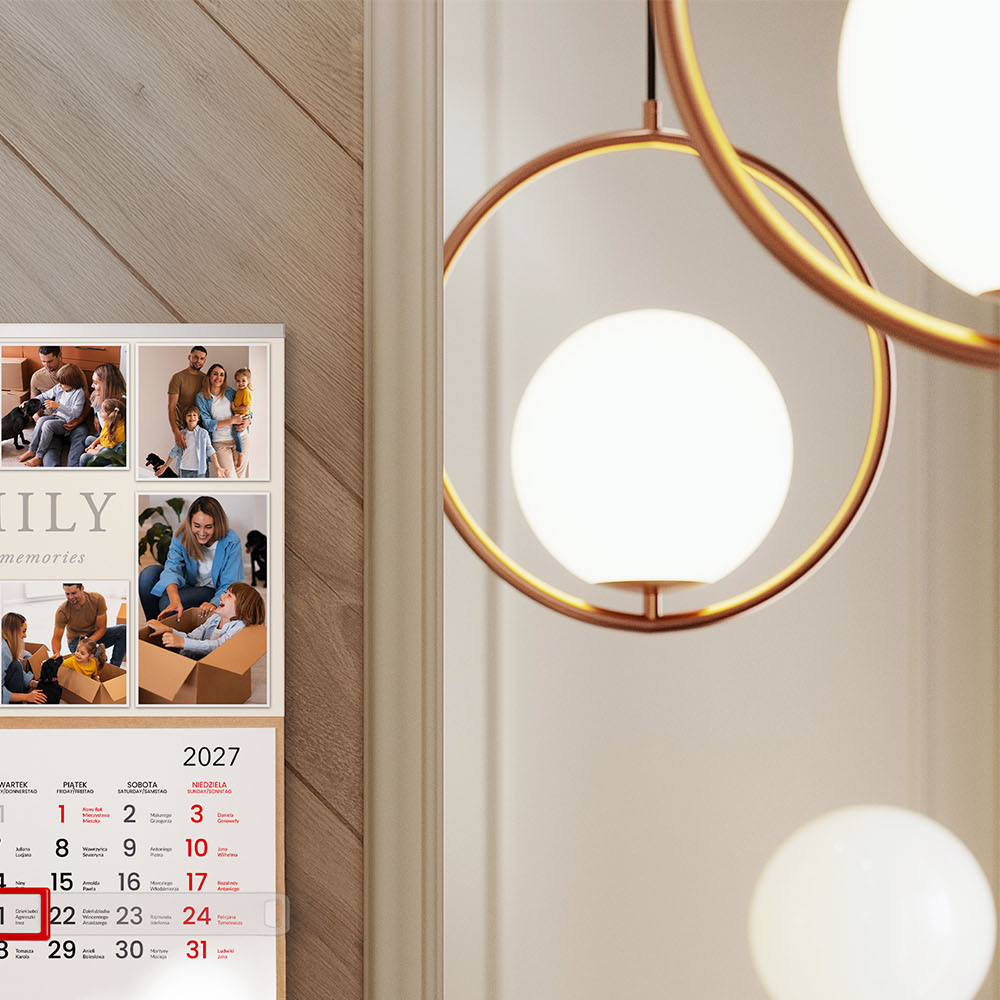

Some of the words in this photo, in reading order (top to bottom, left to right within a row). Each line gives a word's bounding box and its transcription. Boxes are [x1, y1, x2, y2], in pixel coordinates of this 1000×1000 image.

[0, 550, 86, 564] memories
[183, 747, 240, 766] 2027
[63, 781, 87, 789] PIĄTEK
[59, 805, 64, 823] 1
[124, 805, 136, 823] 2
[191, 804, 203, 823] 3
[56, 839, 68, 857] 8
[124, 839, 136, 857] 9
[186, 838, 208, 857] 10
[50, 873, 73, 891] 15
[118, 872, 140, 891] 16
[187, 873, 207, 891] 17
[50, 906, 76, 925] 22
[116, 906, 142, 925] 23
[183, 906, 211, 925] 24
[48, 940, 75, 959] 29
[116, 940, 143, 959] 30
[186, 940, 206, 959] 31
